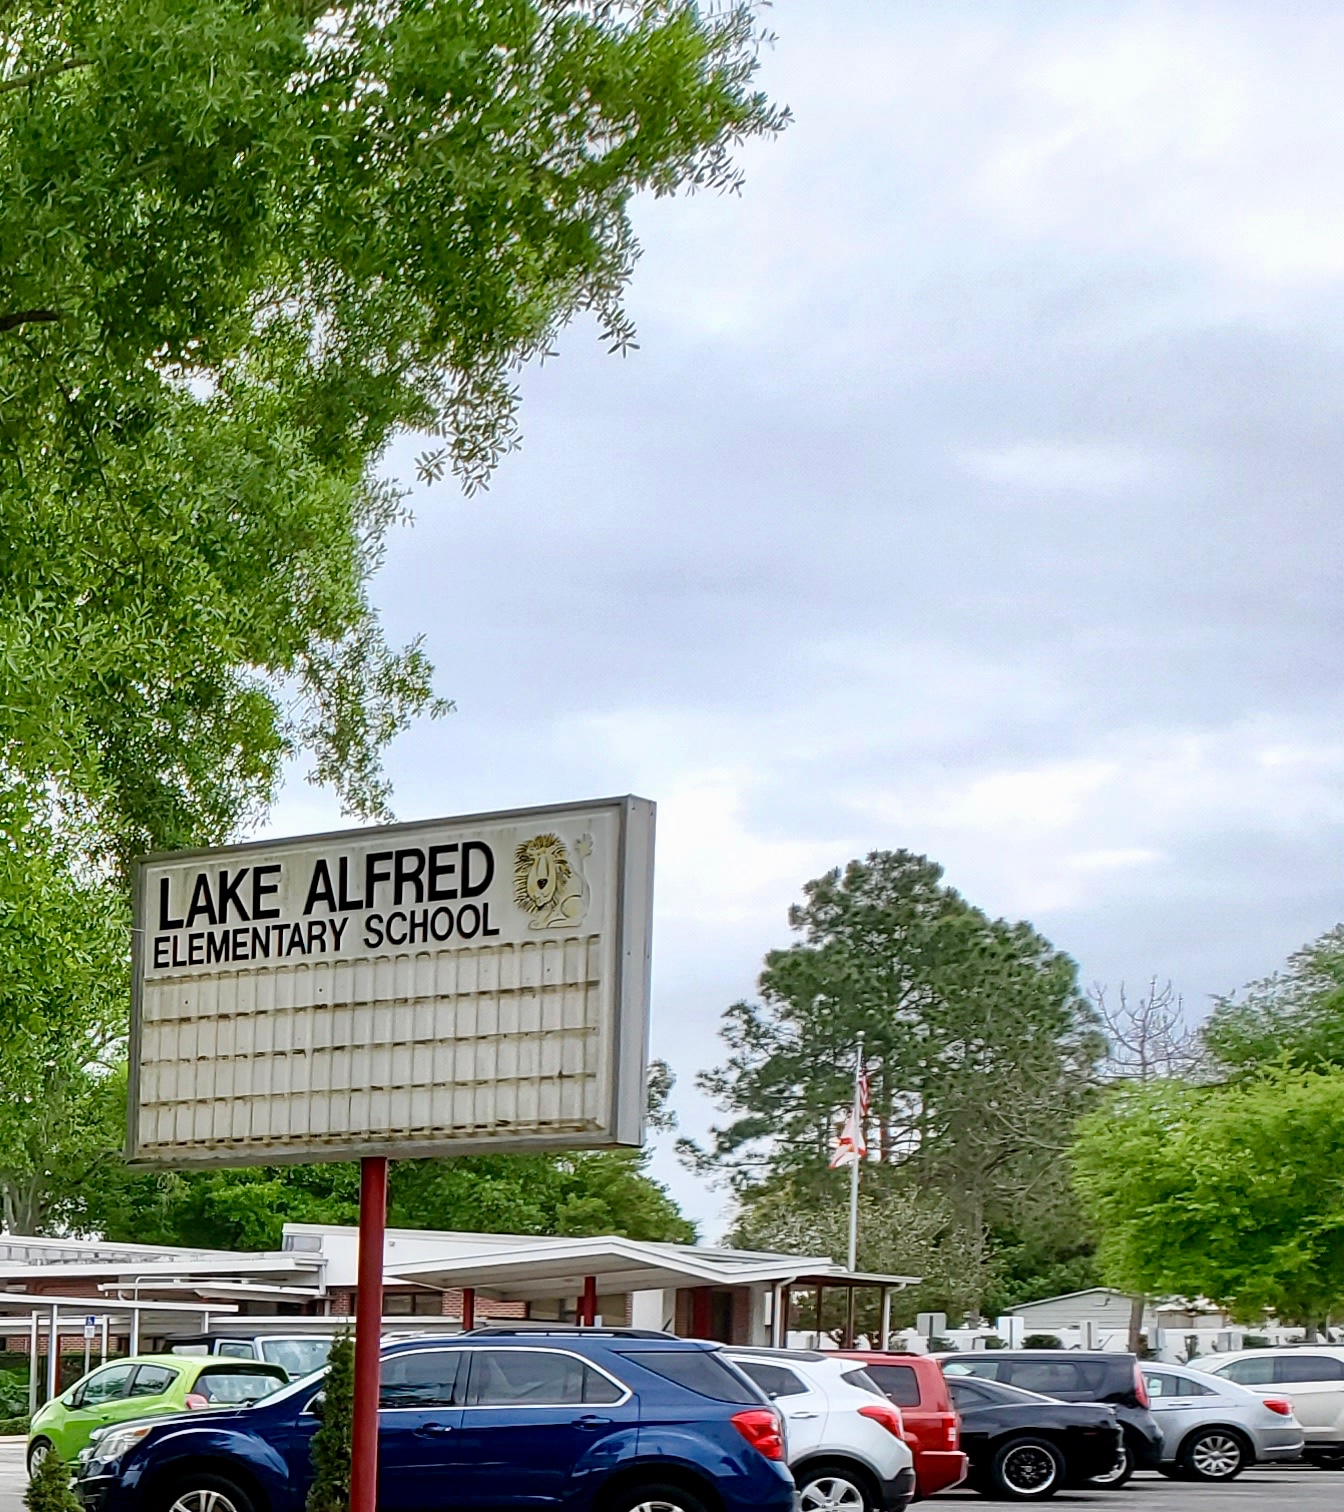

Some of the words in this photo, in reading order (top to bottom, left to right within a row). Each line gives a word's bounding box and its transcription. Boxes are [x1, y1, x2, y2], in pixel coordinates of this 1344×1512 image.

[158, 864, 283, 931] LAKE
[302, 840, 495, 915] ALFRED
[153, 917, 349, 969] ELEMENTARY
[363, 902, 500, 949] SCHOOL
